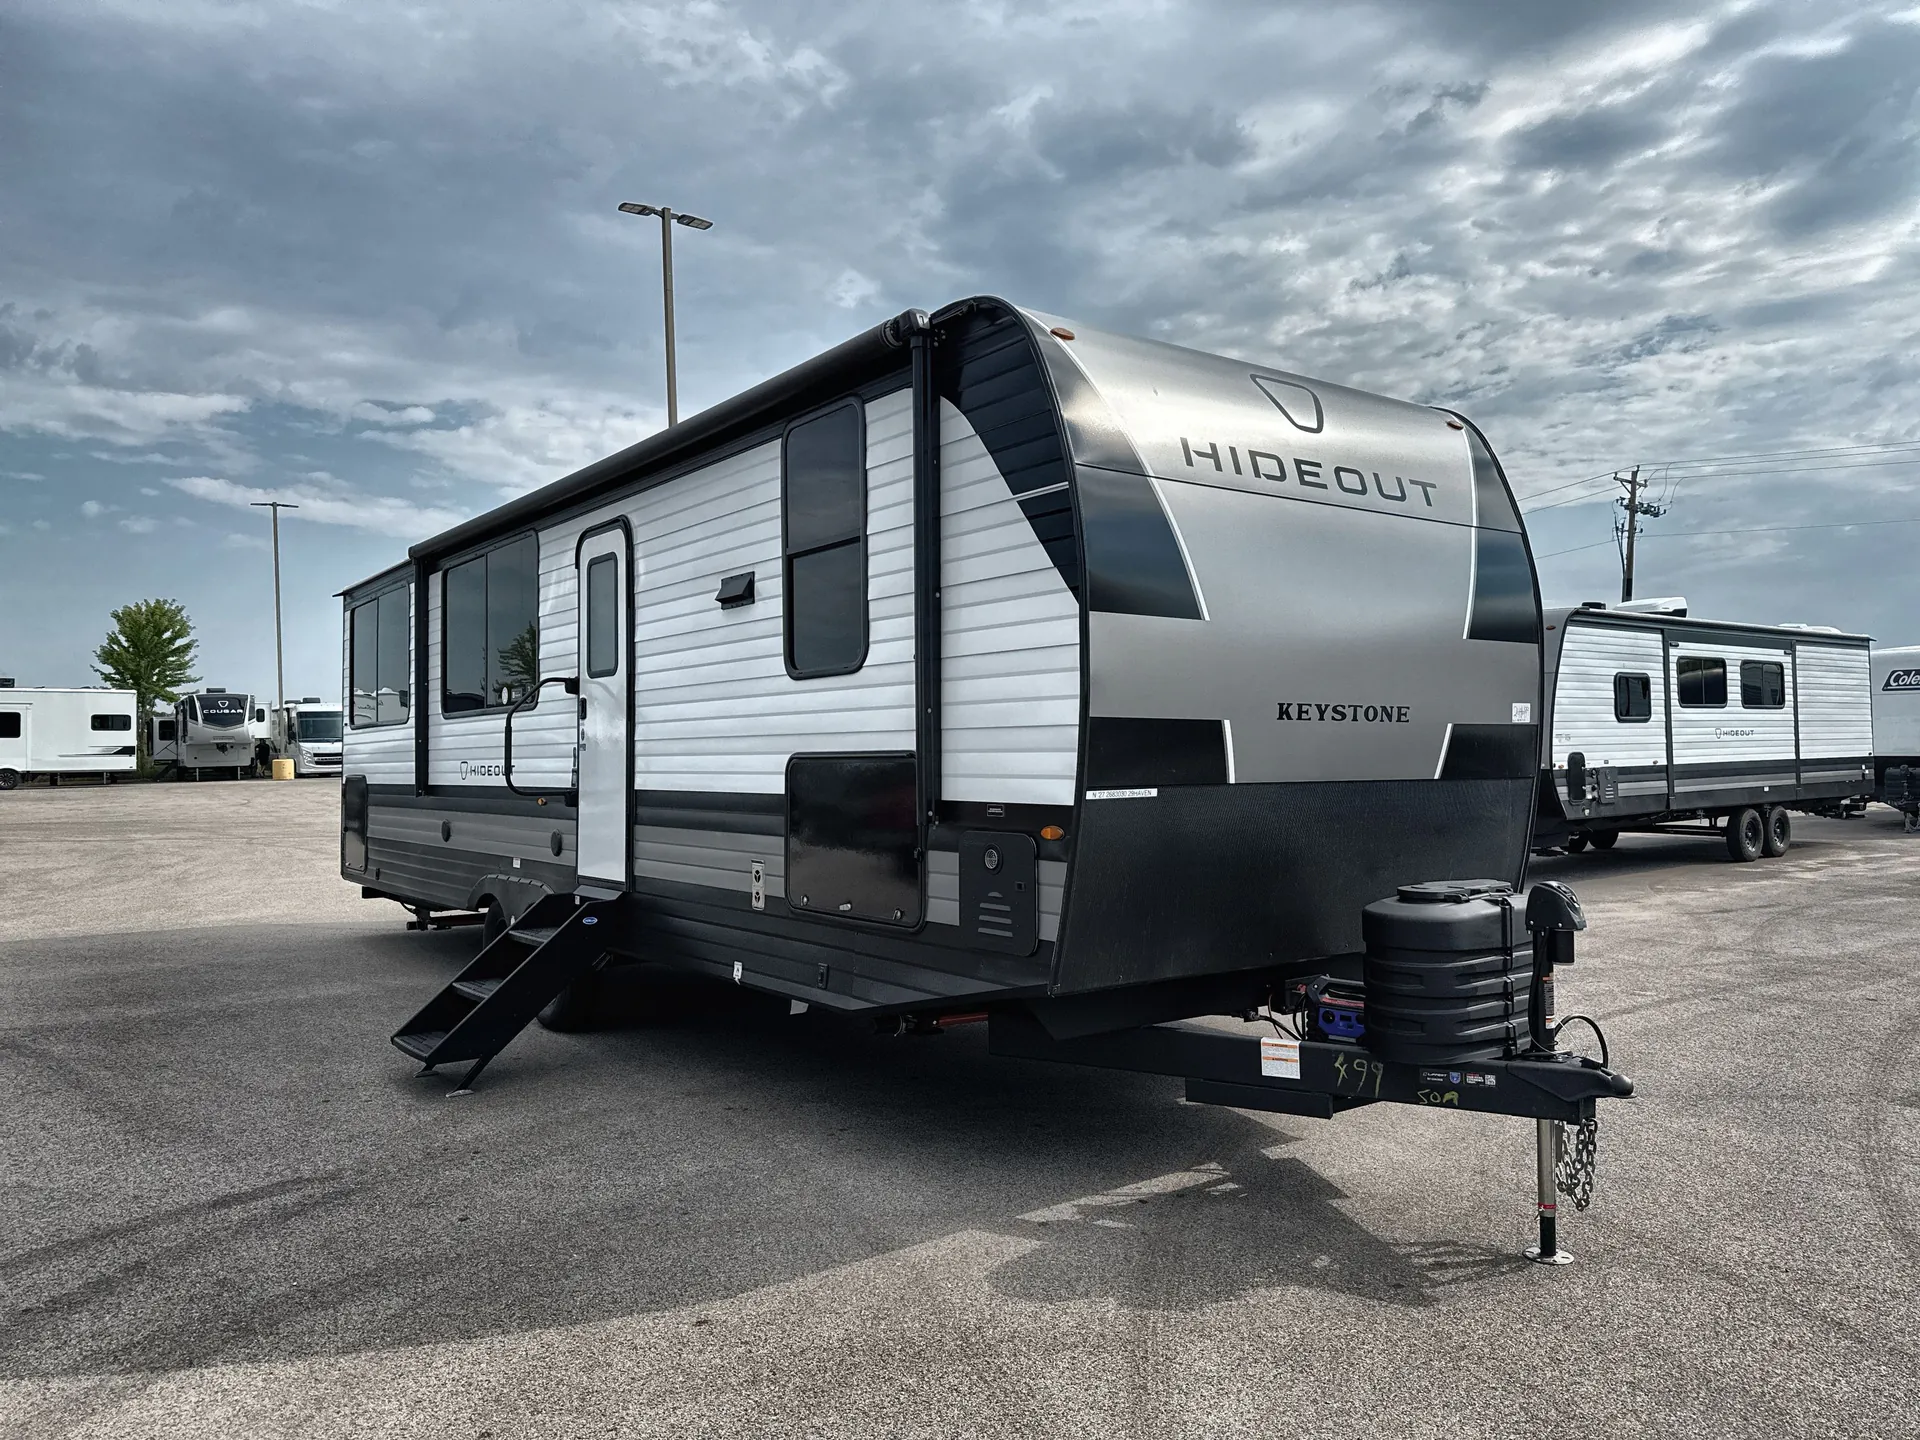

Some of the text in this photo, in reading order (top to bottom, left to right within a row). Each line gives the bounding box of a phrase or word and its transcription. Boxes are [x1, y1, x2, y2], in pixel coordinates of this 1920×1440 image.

[1179, 436, 1437, 507] HIDEOUT
[1889, 670, 1920, 686] Cole
[1276, 702, 1411, 723] KEYSTONE
[1722, 729, 1755, 737] HIDEOUT
